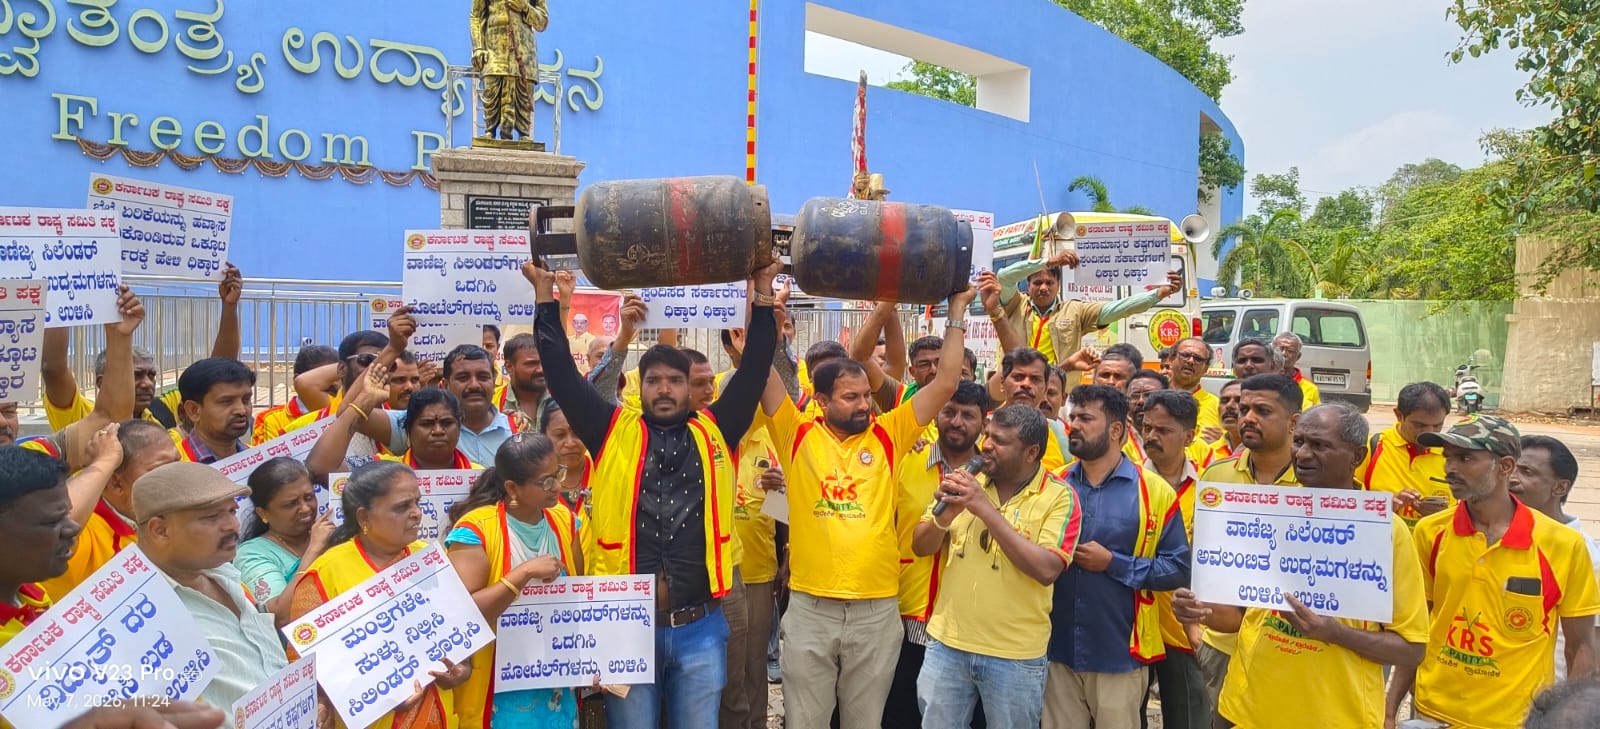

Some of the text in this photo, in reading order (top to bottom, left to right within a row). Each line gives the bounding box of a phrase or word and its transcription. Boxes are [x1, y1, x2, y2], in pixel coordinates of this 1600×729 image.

[281, 27, 604, 117] ಉದ್ಯಾವನ
[51, 93, 371, 166] Freedom
[188, 194, 212, 206] ಸಮಿತಿ
[216, 198, 230, 214] ಪಕ್ಷ
[67, 215, 96, 227] ಸಮಿತಿ
[100, 216, 117, 233] ಪಕ್ಷ
[119, 227, 186, 247] ಕೊಂಡಿರುವ
[427, 234, 469, 246] ಕರ್ನಾಟಕ
[498, 234, 527, 246] ಸಮಿತಿ
[453, 254, 529, 271] ಸಿಲಿಂಡರ್‌ಗ
[16, 285, 41, 305] ಪಕ್ಷ
[455, 279, 497, 293] ಒದಗಿಸಿ
[691, 286, 747, 299] ಸರ್ಕಾರಗ
[58, 304, 93, 322] ಉಳಿಸಿ
[508, 302, 536, 316] ಉಳಿ
[664, 304, 736, 322] ಧಿಕ್ಕಾರ ಧಿಕ್ಕಾರ
[414, 331, 446, 345] ಒದಗಿಸಿ
[1160, 328, 1179, 337] KRS
[1207, 369, 1227, 377] ARTY
[291, 429, 318, 447] ಸಮಿತಿ
[436, 475, 463, 486] ಸಮಿತಿ
[820, 480, 858, 501] KRS
[1224, 490, 1280, 505] ಕರ್ನಾಟಕ
[1320, 495, 1358, 510] ಸಮಿತಿ
[1364, 496, 1387, 518] ಪಕ್ಷ
[1197, 545, 1388, 592] ಅವಲಂಬಿತ ಉದ್ಯಮಗಳನ್ನು
[314, 593, 364, 629] ಕರ್ನಾಟಕ
[392, 563, 420, 585] ಸಮಿತಿ
[422, 549, 444, 567] ಪಕ್ಷ
[522, 582, 566, 596] ಕರ್ನಾಟಕ
[599, 581, 628, 593] ಸಮಿತಿ
[633, 579, 650, 595] ಪಕ್ಷ
[1238, 583, 1284, 605] ಉಳಿಸಿ
[5, 617, 64, 673] ಕರ್ನಾಟಕ
[90, 570, 125, 602] ಸಮಿತಿ
[122, 551, 150, 575] ಪಕ್ಷ
[120, 592, 157, 634] ದರ
[405, 611, 446, 644] ನಿಲ್ಲಿಸಿ
[1278, 620, 1303, 638] PAR
[552, 631, 597, 650] ಒದಗಿಸಿ
[1446, 624, 1493, 657] KRS
[608, 656, 648, 674] ಉಳಿಸಿ
[1449, 648, 1482, 665] PARTY
[348, 655, 420, 717] ಸಿಲಿಂಡರ್
